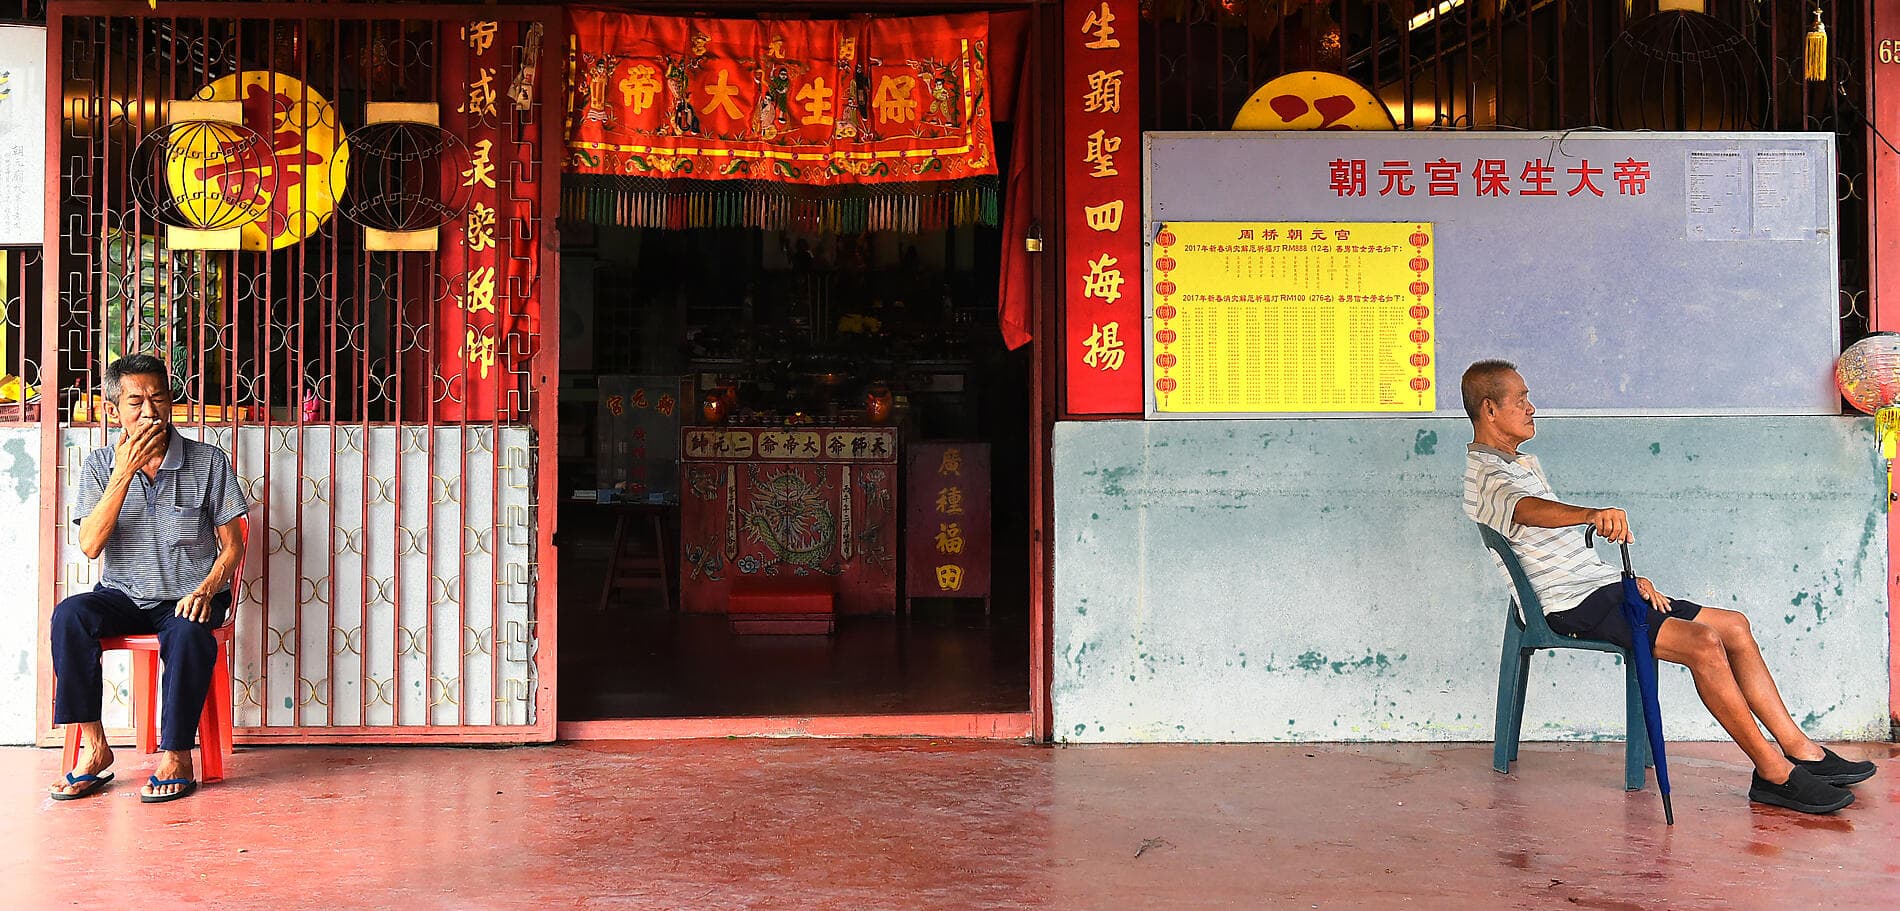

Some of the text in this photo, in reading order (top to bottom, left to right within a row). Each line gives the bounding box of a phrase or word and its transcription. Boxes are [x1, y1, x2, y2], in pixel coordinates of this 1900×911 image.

[1082, 1, 1126, 371] 生顯聖四海揚
[1328, 157, 1653, 198] 朝元宫保生大帝
[935, 447, 965, 592] 廣種福田
